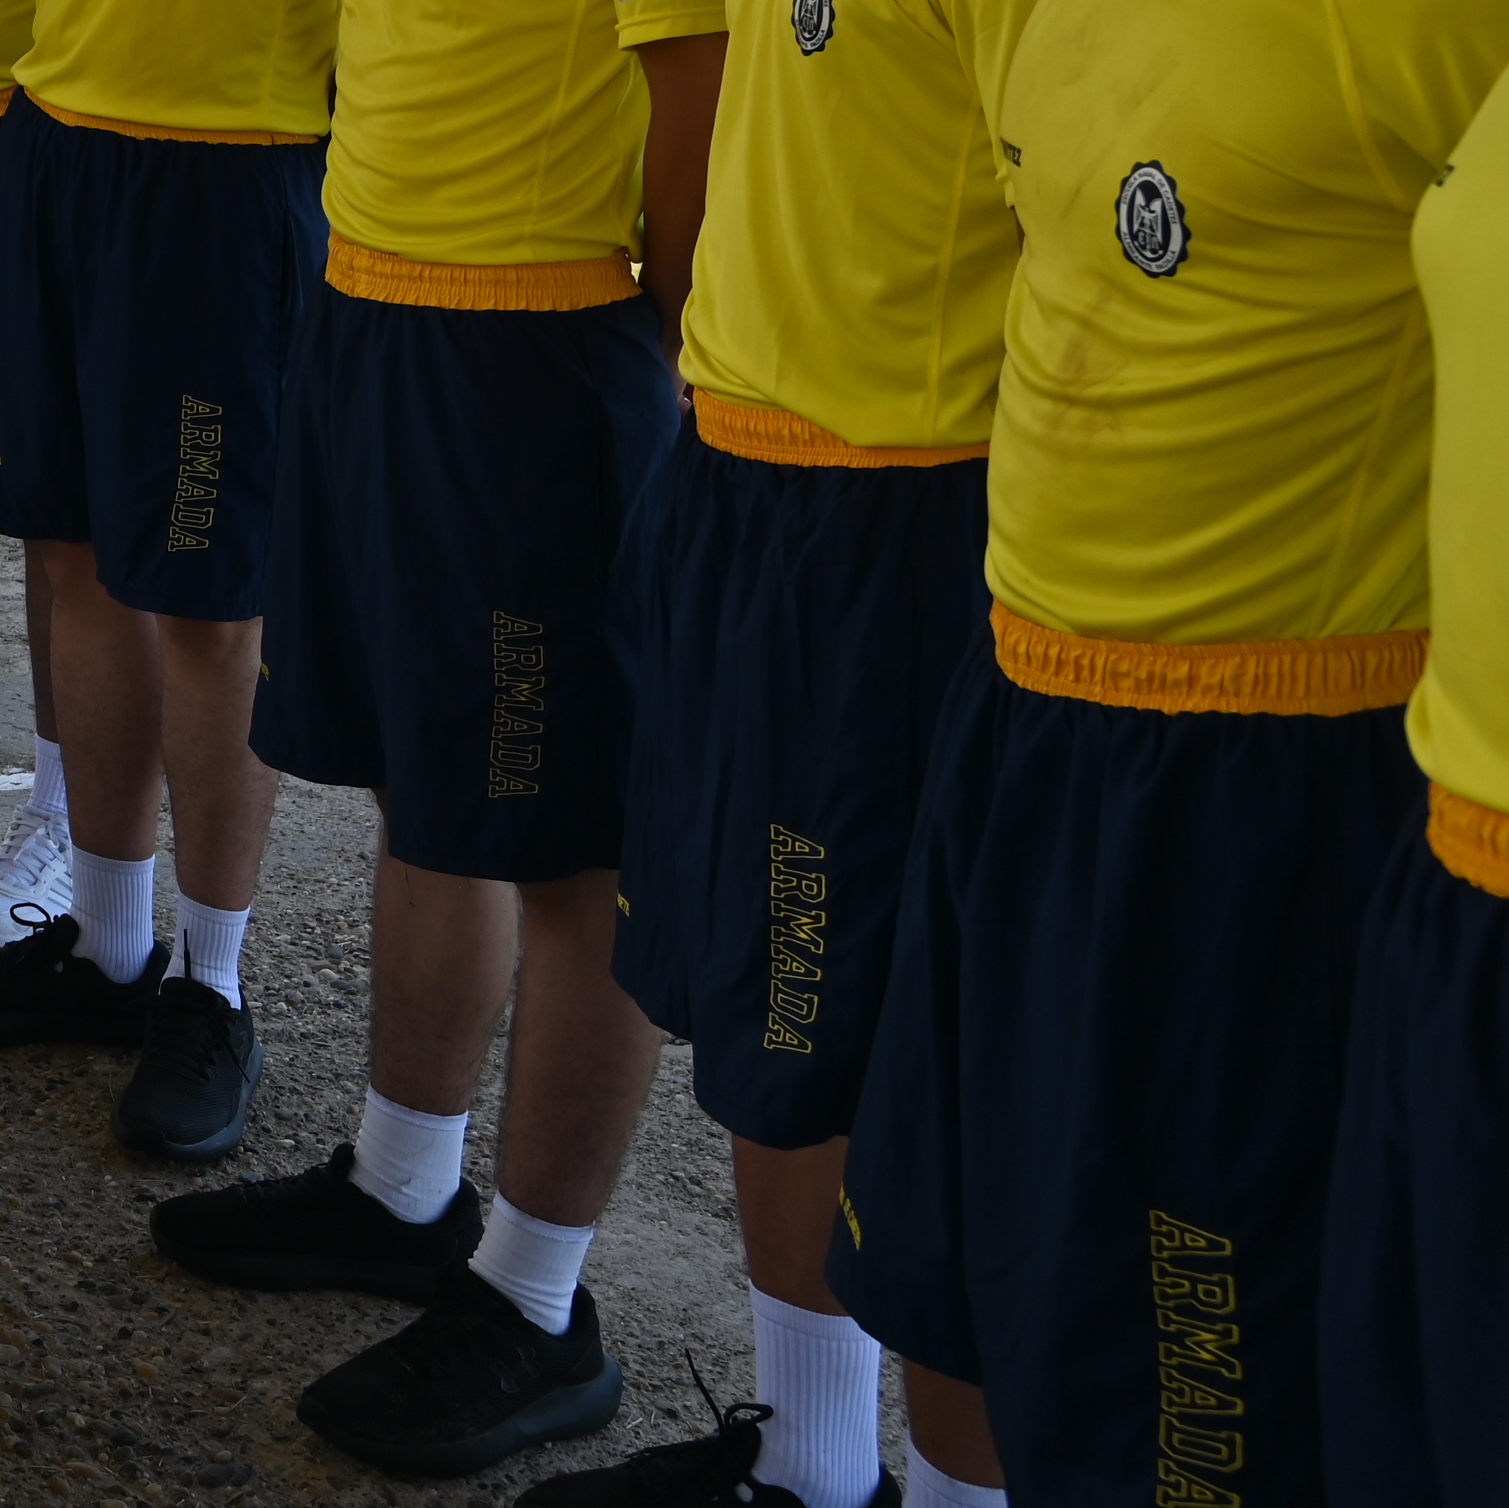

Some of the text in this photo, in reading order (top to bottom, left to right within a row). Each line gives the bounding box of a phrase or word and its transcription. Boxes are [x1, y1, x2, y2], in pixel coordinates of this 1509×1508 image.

[167, 394, 223, 553] ARMADA
[488, 609, 547, 800] ARMADA
[763, 822, 827, 1054] ARMADA
[1148, 1208, 1244, 1508] ARMADA
